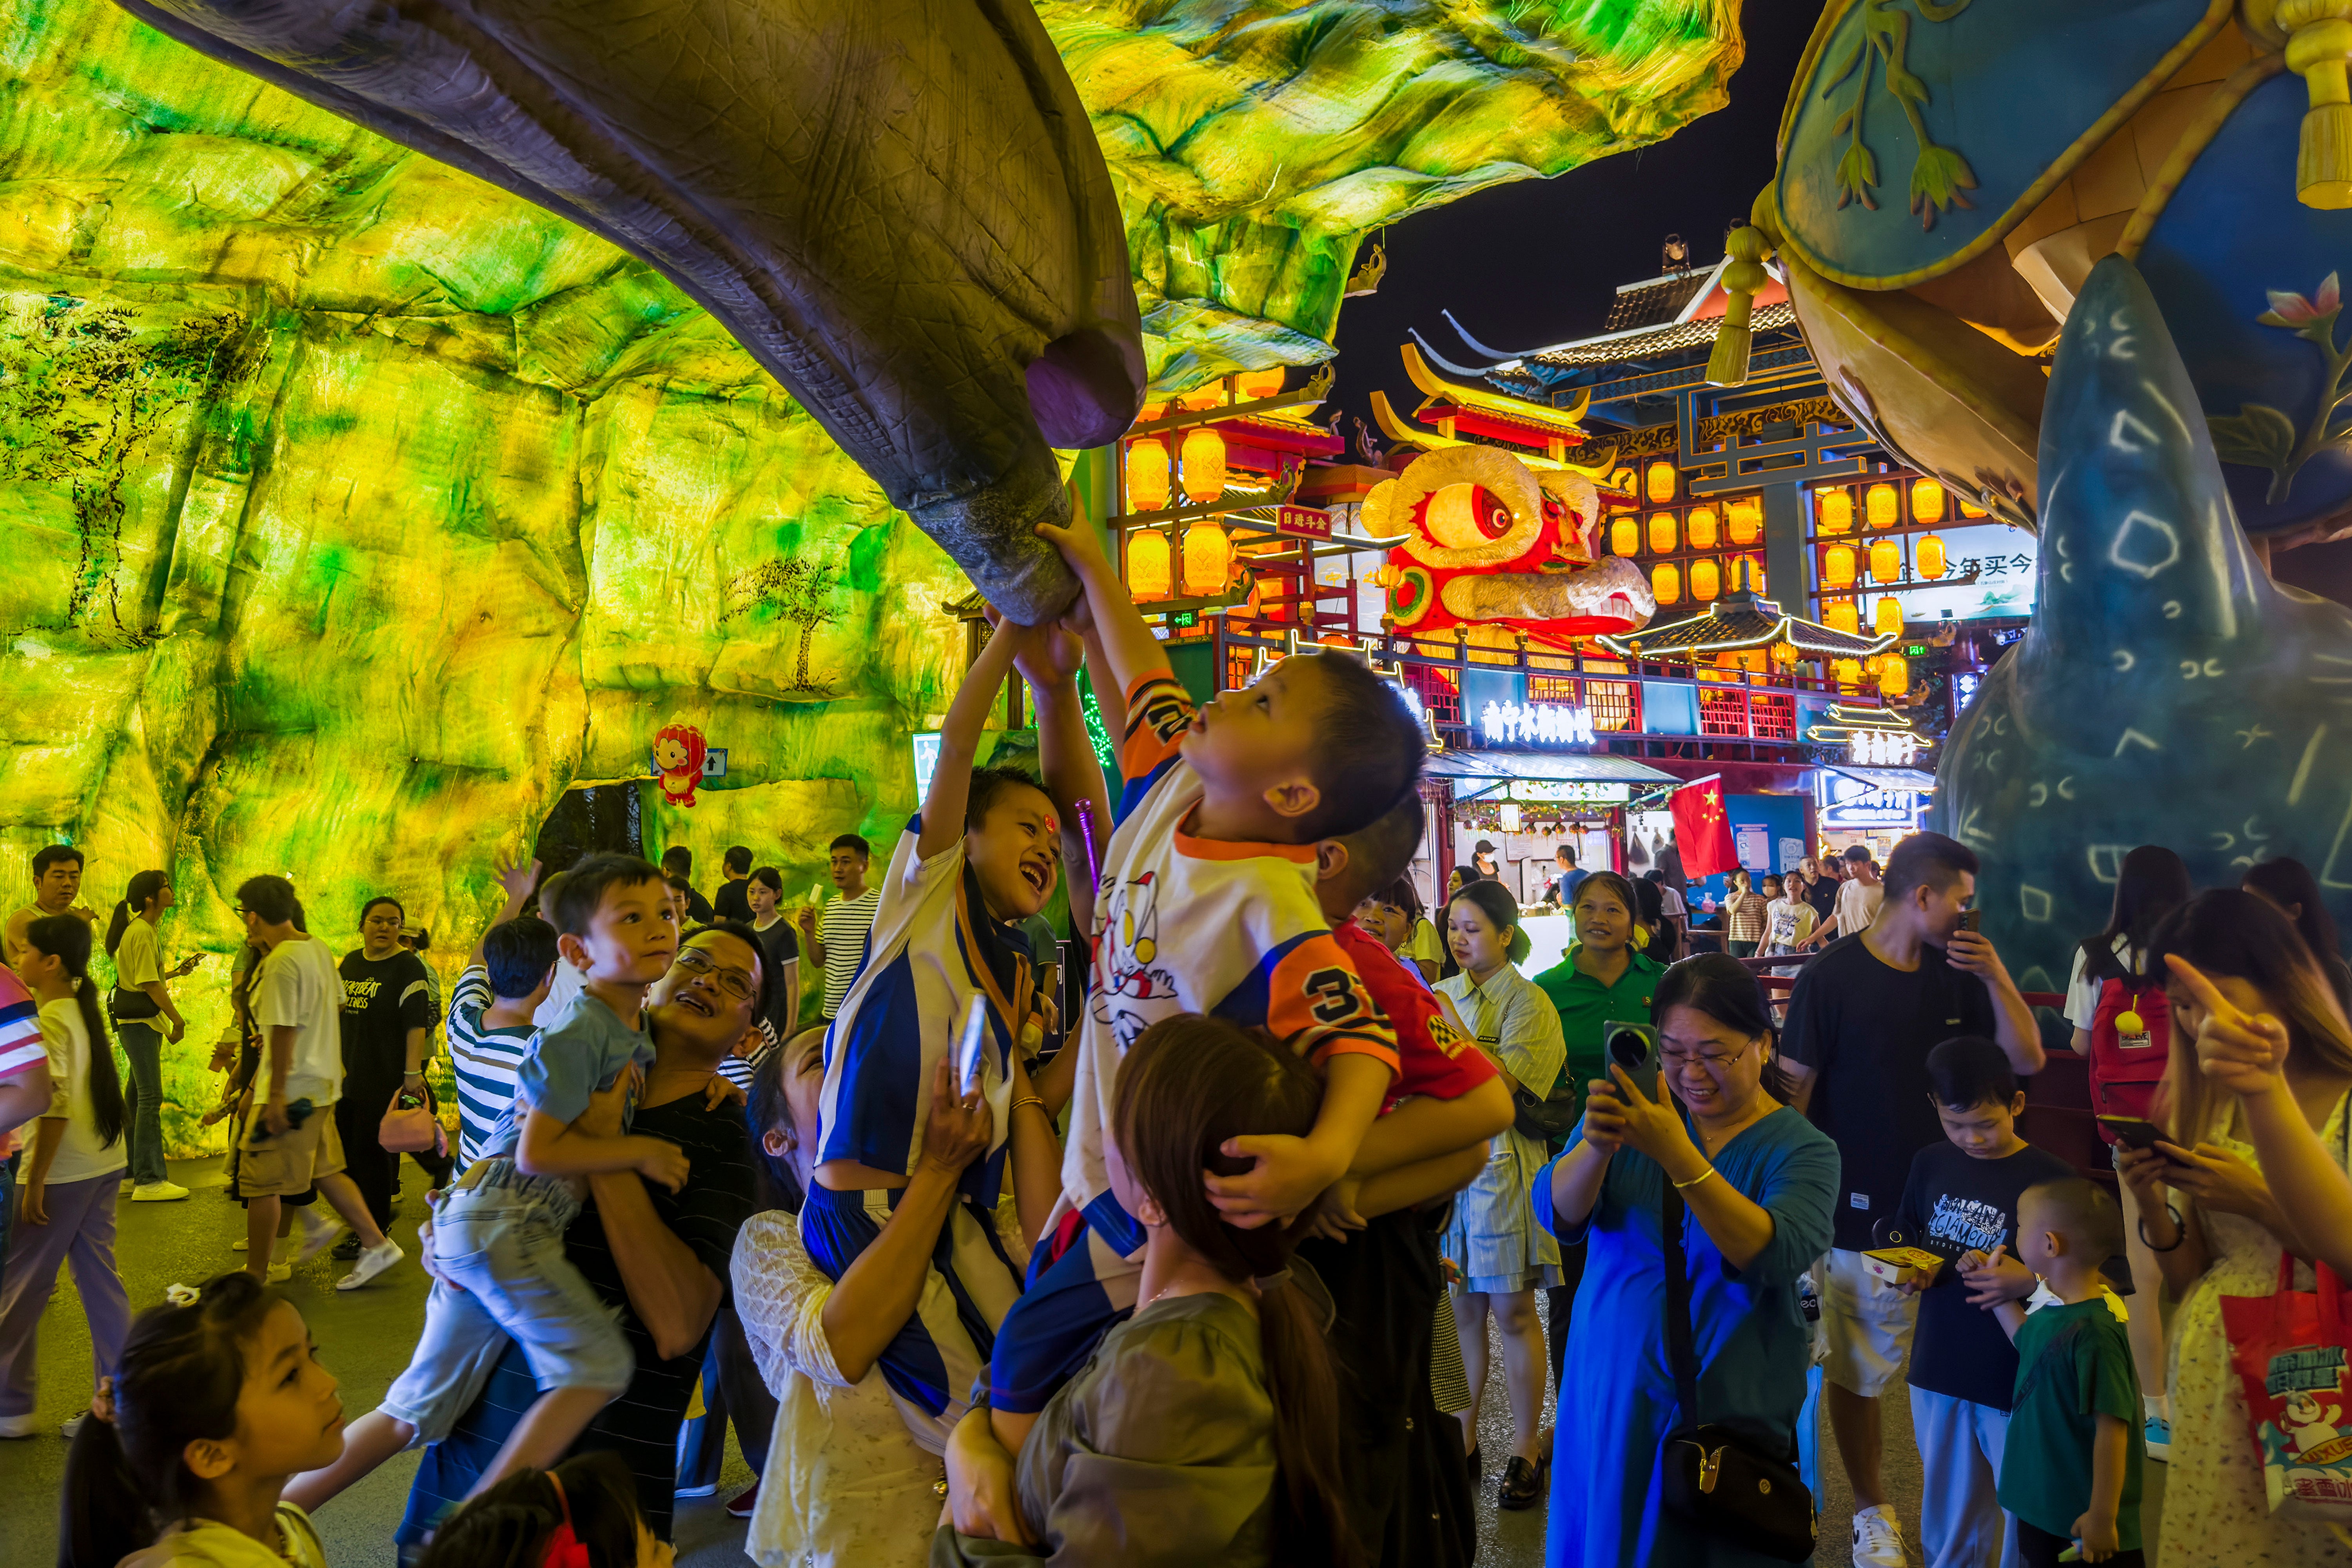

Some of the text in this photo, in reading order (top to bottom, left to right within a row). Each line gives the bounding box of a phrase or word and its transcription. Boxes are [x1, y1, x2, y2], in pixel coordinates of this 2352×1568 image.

[1284, 512, 1327, 530] 日进斗金
[1945, 553, 2037, 579] 今年买今
